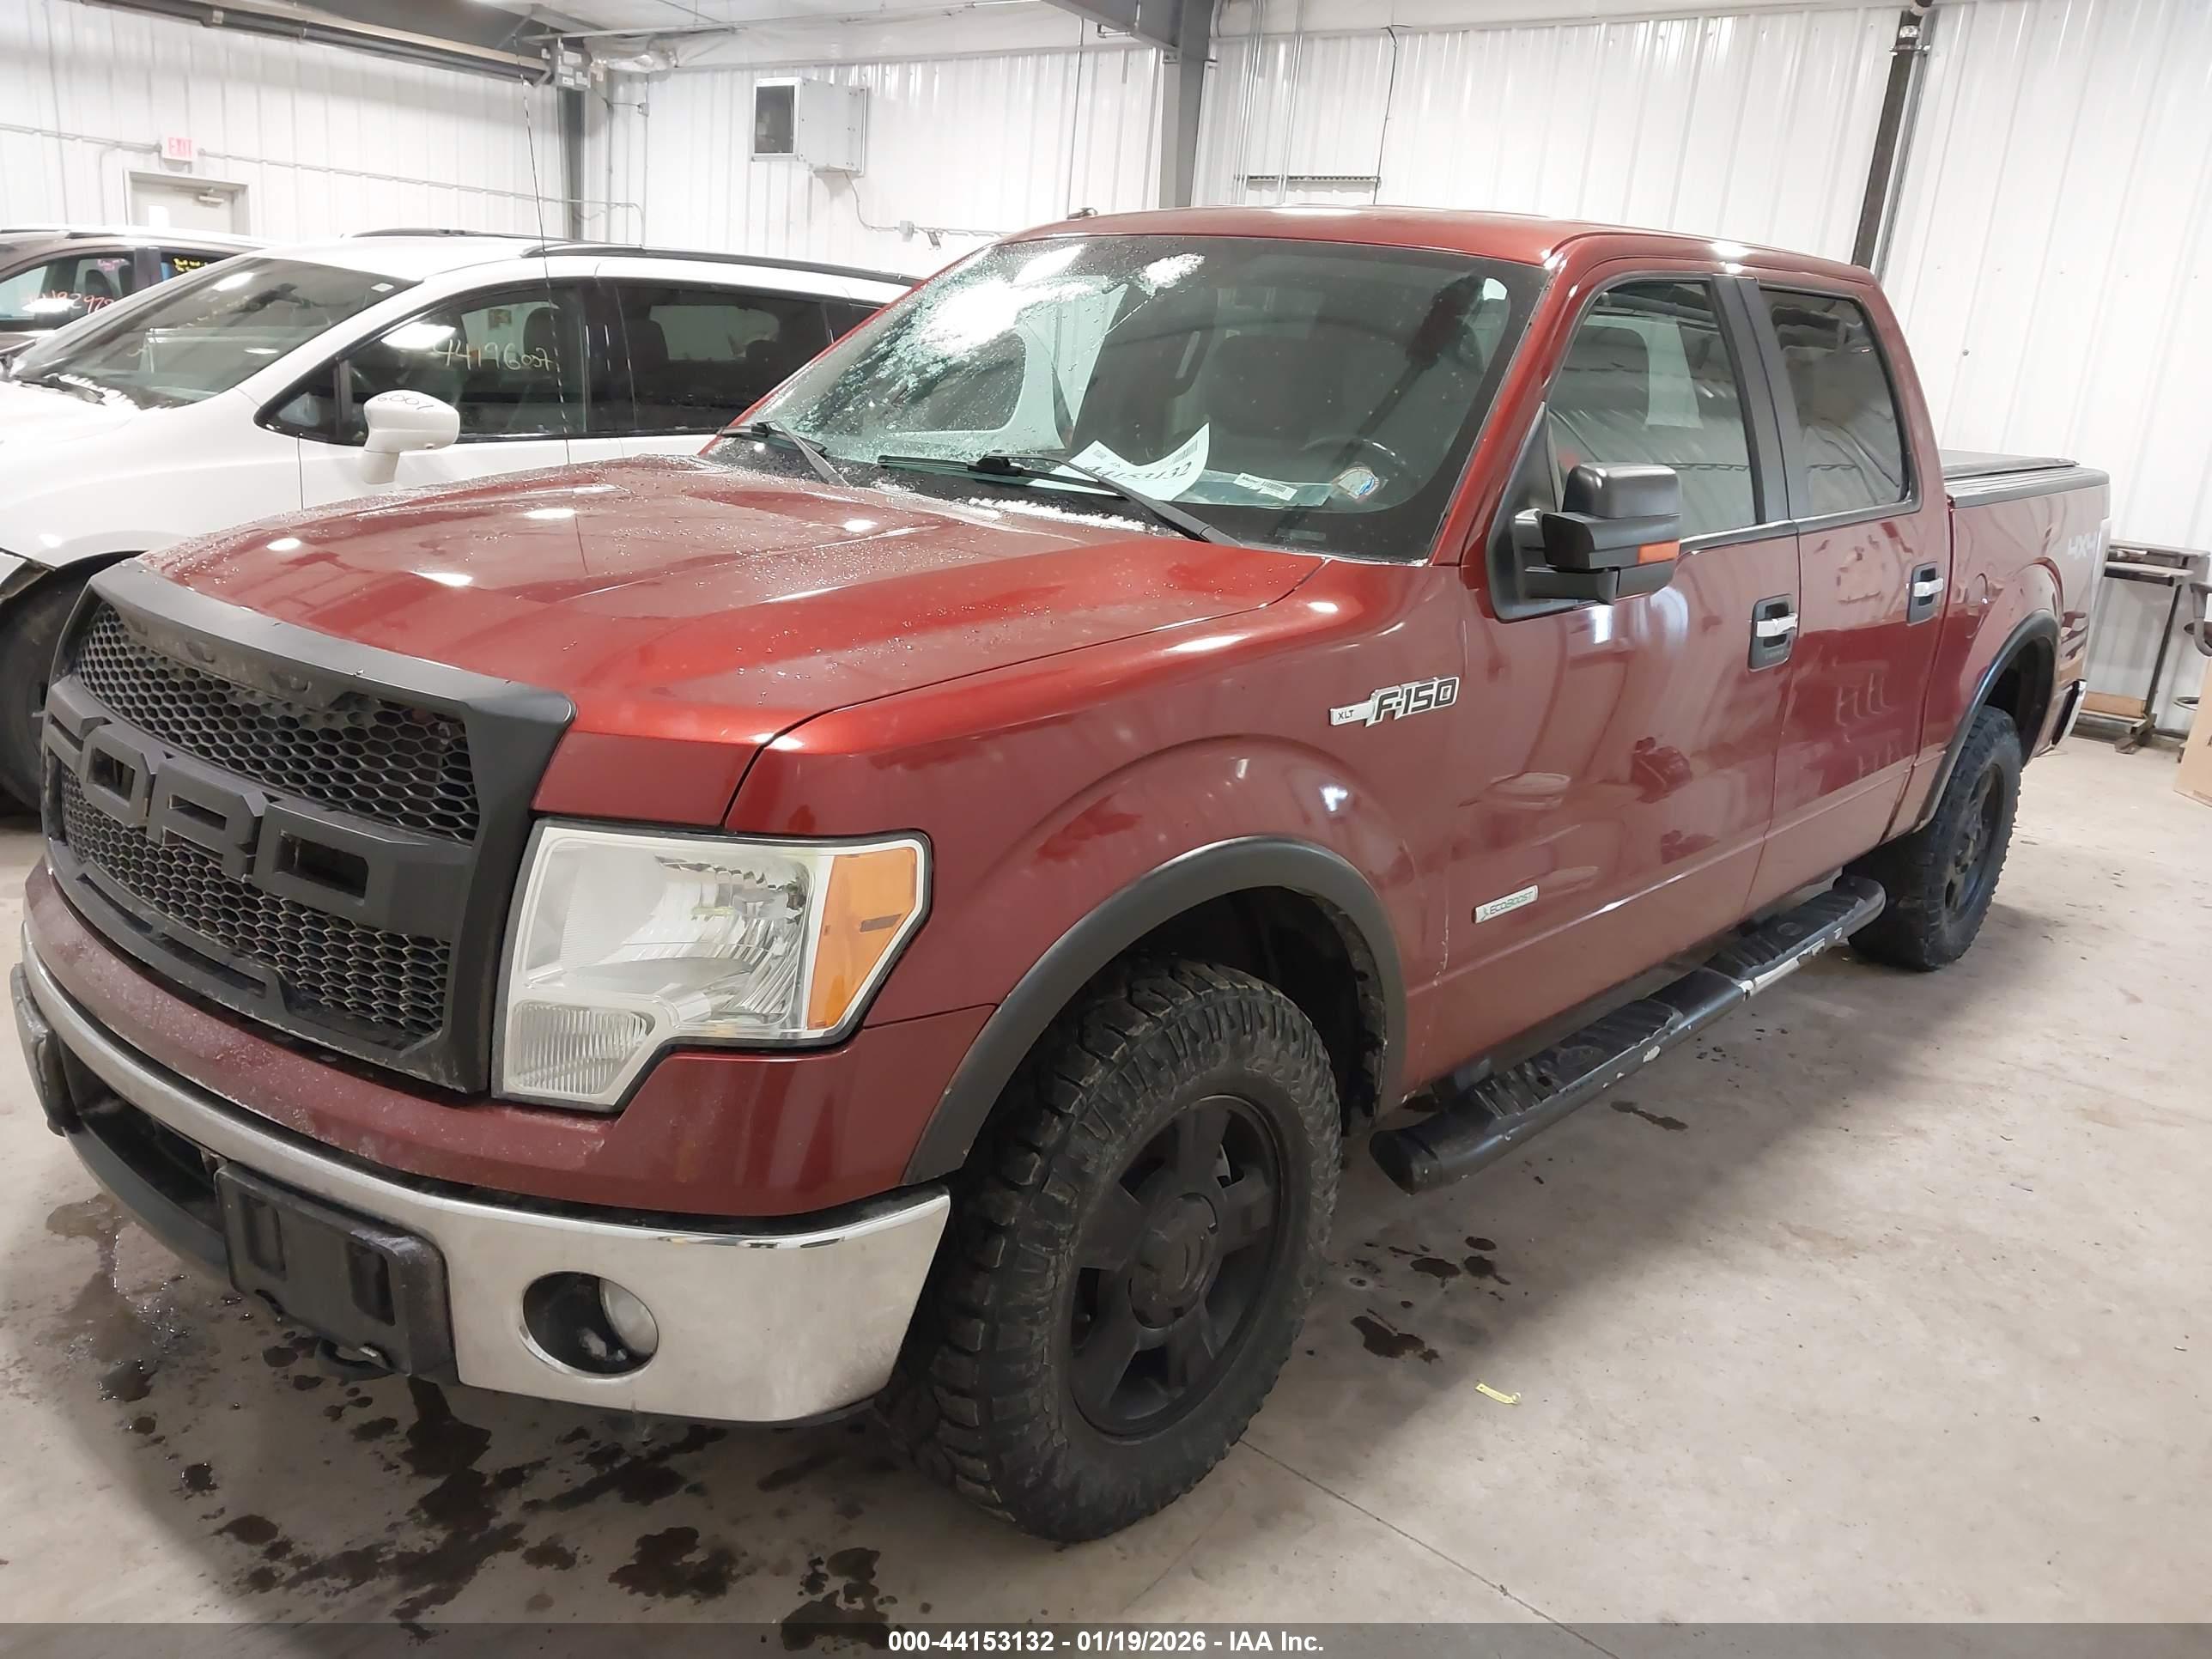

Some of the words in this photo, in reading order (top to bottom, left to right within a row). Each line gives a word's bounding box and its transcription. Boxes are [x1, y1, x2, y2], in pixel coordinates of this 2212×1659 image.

[168, 137, 192, 156] EXIT
[1338, 709, 1354, 720] XLT
[1372, 677, 1460, 724] F-150
[43, 685, 393, 924] FORD
